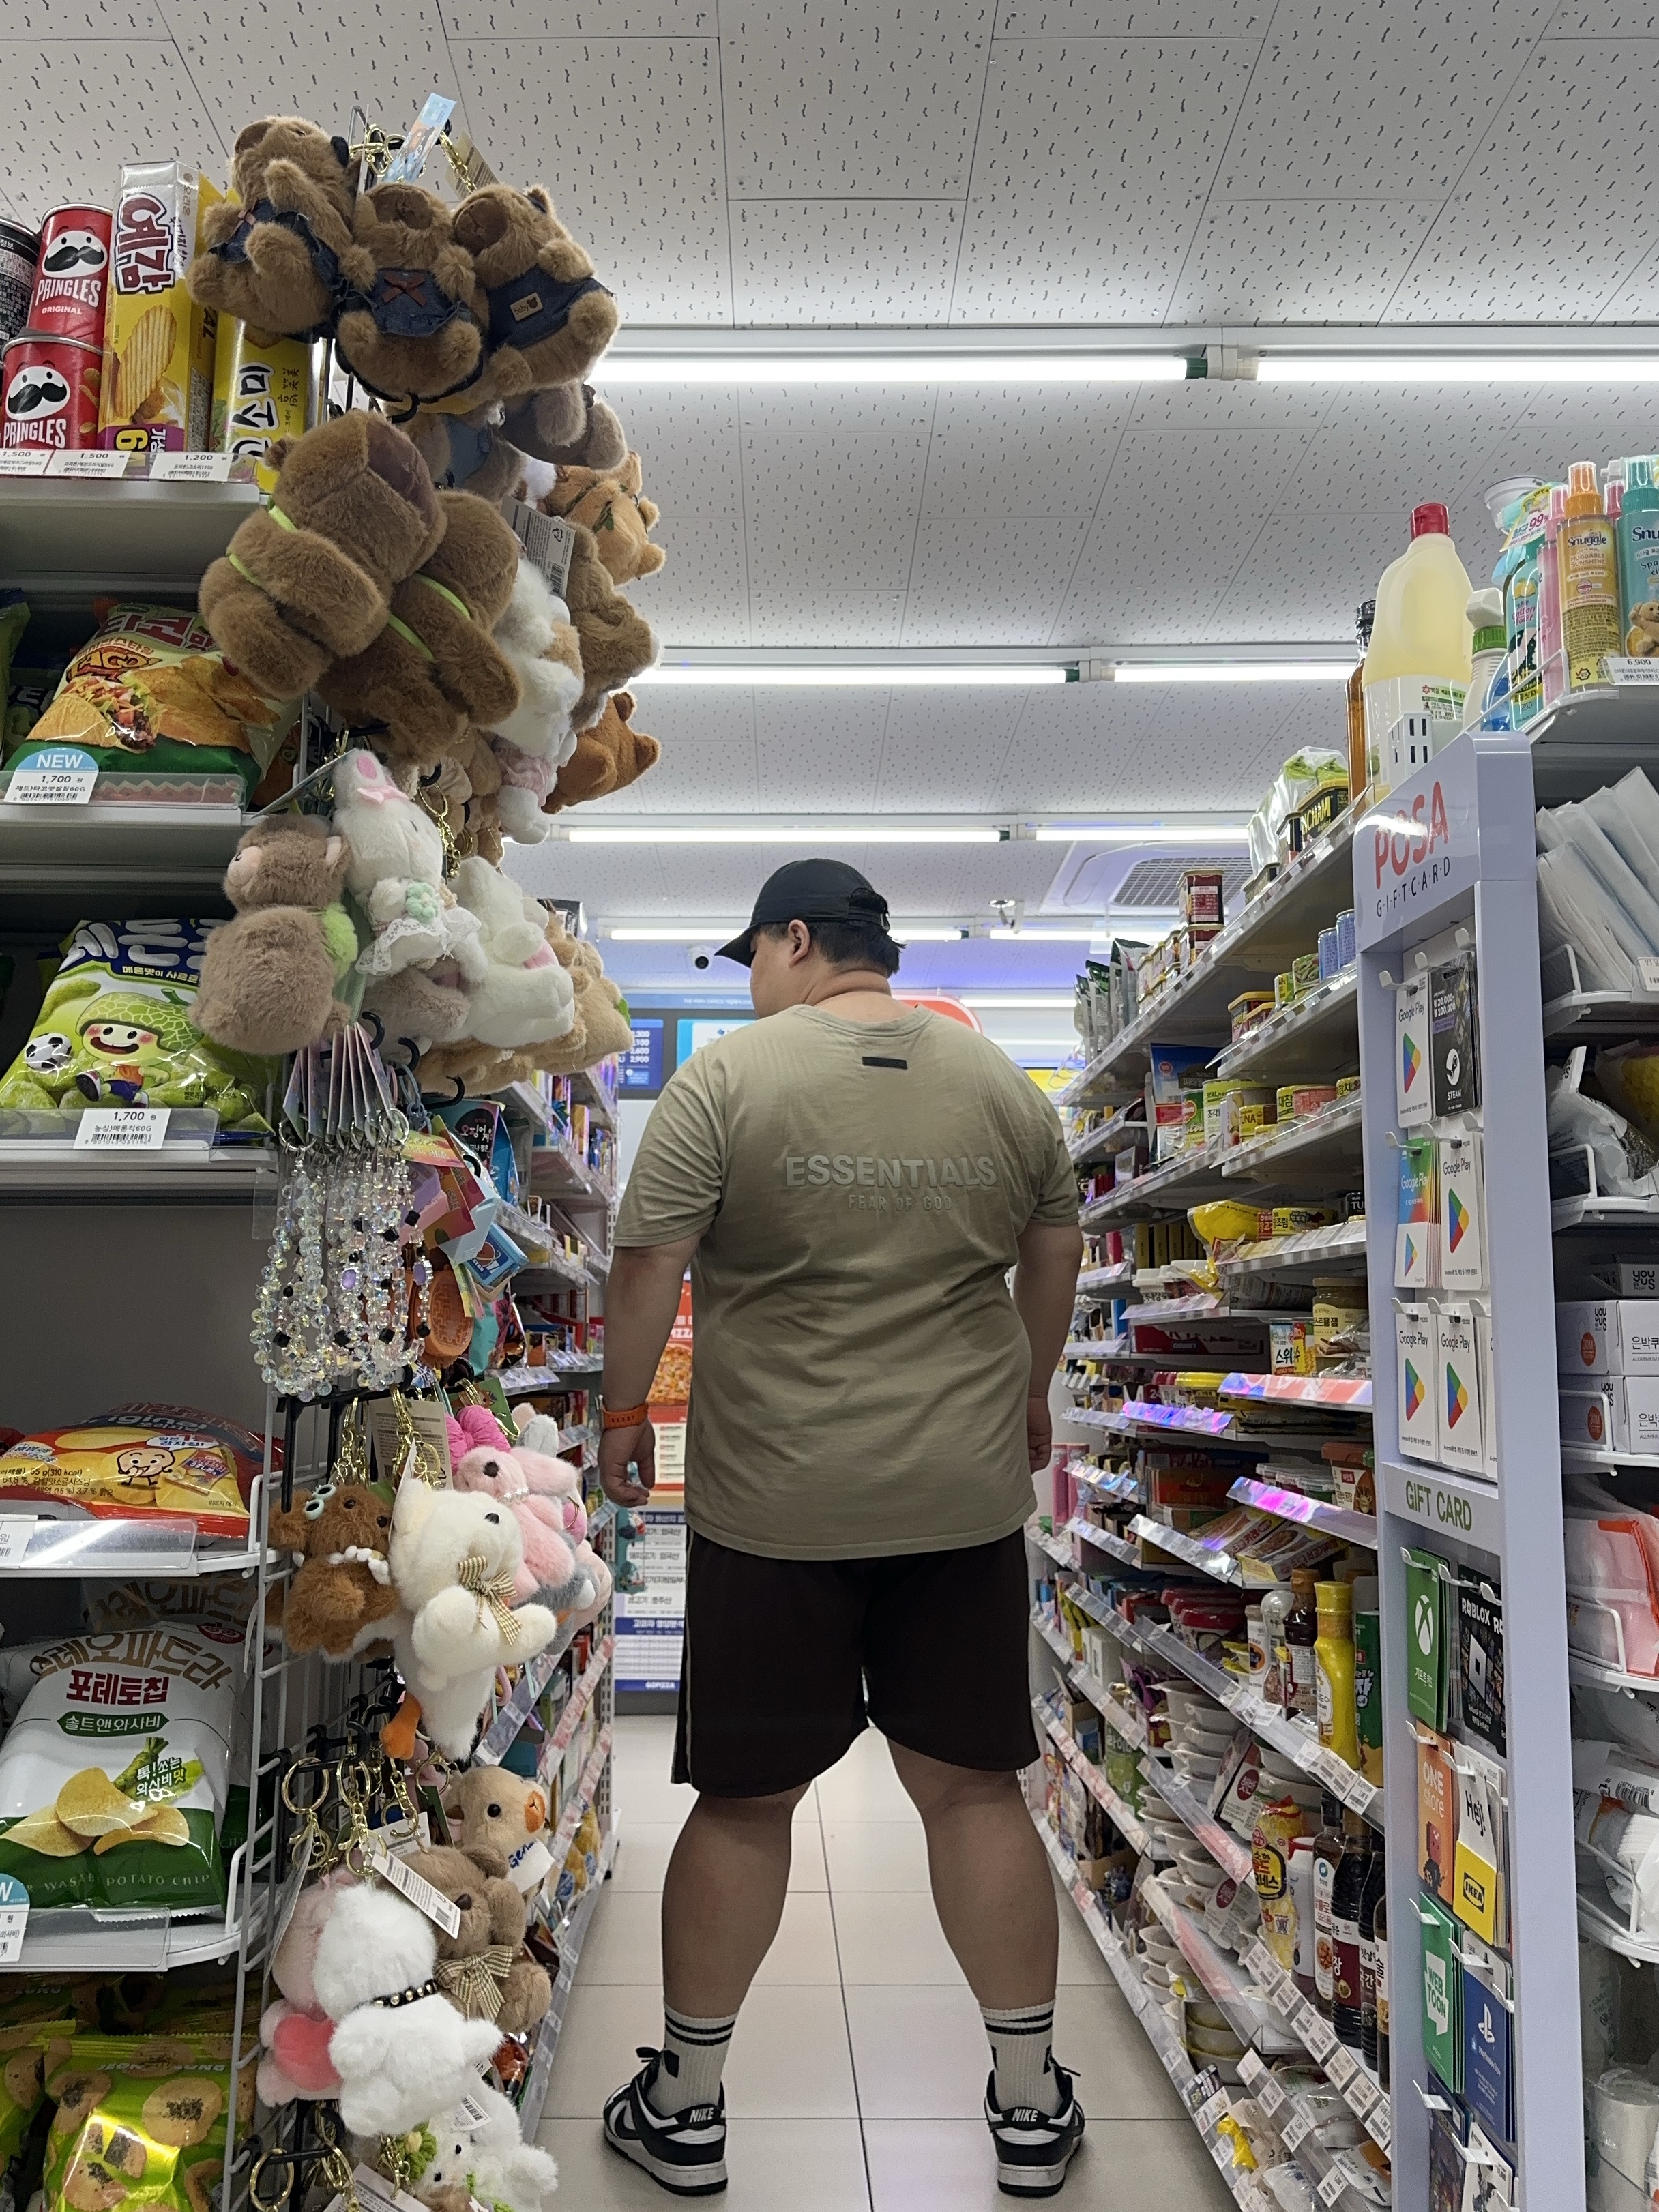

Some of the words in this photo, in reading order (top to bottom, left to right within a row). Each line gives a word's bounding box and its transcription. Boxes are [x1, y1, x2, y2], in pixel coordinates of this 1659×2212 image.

[117, 194, 173, 292] 예감
[35, 278, 102, 308] PRINGLES
[42, 306, 82, 315] ORIGINAL
[514, 303, 529, 315] baby
[3, 418, 66, 448] PRINGLES
[1568, 533, 1607, 548] Snuggle
[36, 754, 83, 769] NEW
[42, 775, 72, 784] 1,700
[1374, 781, 1450, 889] POSA
[1398, 1004, 1415, 1023] Google
[1415, 1001, 1425, 1017] Play
[1447, 1088, 1462, 1101] STEAM
[114, 1112, 145, 1121] 1,700
[785, 1154, 997, 1188] ESSENTIALS
[1443, 1160, 1460, 1178] Google
[1460, 1157, 1471, 1175] Play
[1401, 1173, 1418, 1192] Google
[1418, 1172, 1429, 1190] Play
[848, 1194, 887, 1211] FEAR
[896, 1196, 913, 1212] OF
[924, 1195, 952, 1211] GOD
[1399, 1330, 1418, 1348] Google
[1418, 1331, 1428, 1349] Play
[1441, 1333, 1458, 1352] Google
[1459, 1334, 1471, 1353] Play
[1405, 1480, 1432, 1518] GIFT
[1437, 1490, 1473, 1532] CARD
[1462, 1597, 1491, 1626] ROBLOX
[66, 1669, 170, 1705] 포테토칩
[65, 1715, 161, 1732] 솔트앤와사비
[137, 1762, 157, 1781] 톡!
[158, 1757, 182, 1774] 쏘는
[1424, 1760, 1445, 1796] ONE
[1424, 1790, 1445, 1819] store
[1465, 1789, 1486, 1838] Hej!
[106, 1875, 165, 1887] POTATO
[1464, 1878, 1484, 1904] IKEA
[1428, 1968, 1443, 1994] WEB
[1427, 1983, 1446, 2020] TOON
[688, 2107, 715, 2123] NIKE
[1011, 2108, 1039, 2123] NIKE
